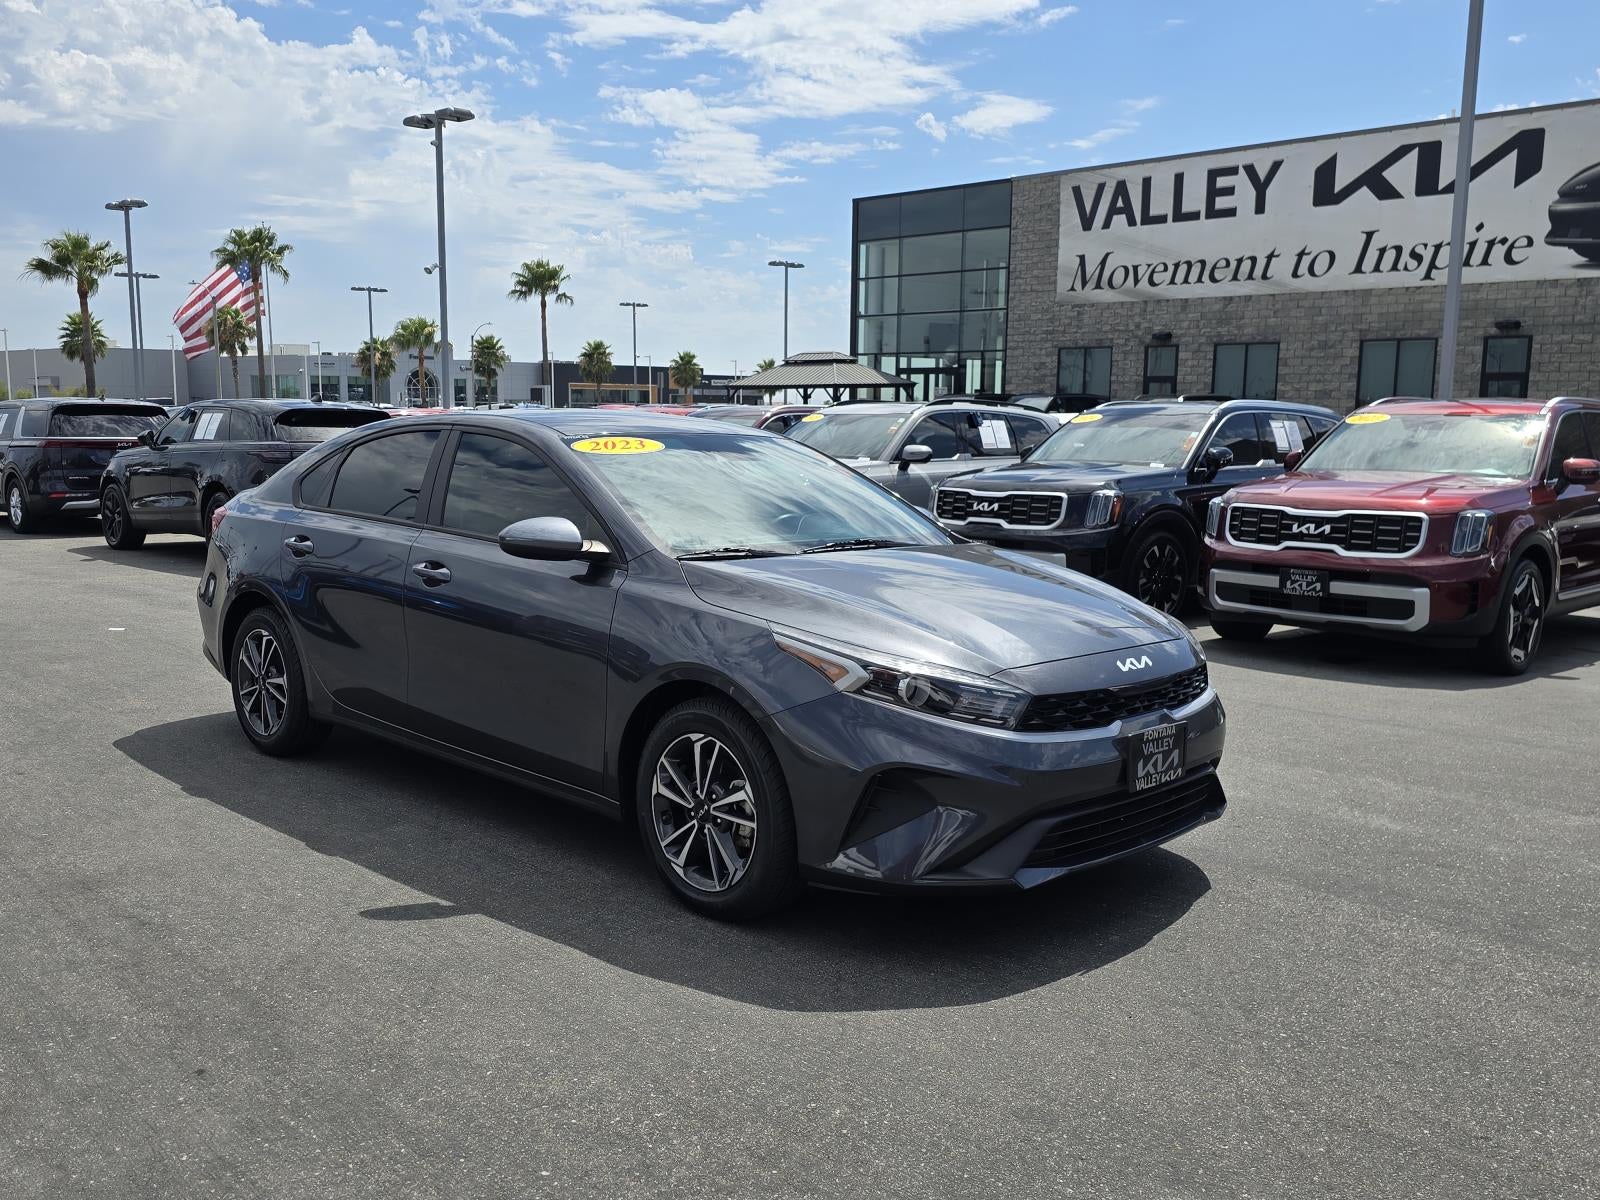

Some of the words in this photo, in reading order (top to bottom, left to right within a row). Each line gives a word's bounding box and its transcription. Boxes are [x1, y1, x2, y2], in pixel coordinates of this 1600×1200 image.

[1071, 159, 1284, 232] VALLEY
[1312, 127, 1546, 207] KIA
[1066, 248, 1281, 292] Movement
[1291, 244, 1336, 279] to
[1348, 222, 1534, 281] Inspire
[589, 440, 646, 451] 2023
[973, 502, 999, 511] KIA
[1292, 522, 1331, 535] KIA
[1286, 580, 1321, 591] KIA
[1291, 574, 1318, 582] VALLEY
[1283, 588, 1304, 596] VALLEY
[1116, 655, 1153, 672] KIA
[1143, 725, 1176, 741] FONTANA
[1142, 737, 1175, 756] VALLEY
[1137, 749, 1179, 778] KIA
[1135, 772, 1162, 791] VALLEY
[1161, 767, 1182, 783] KIA
